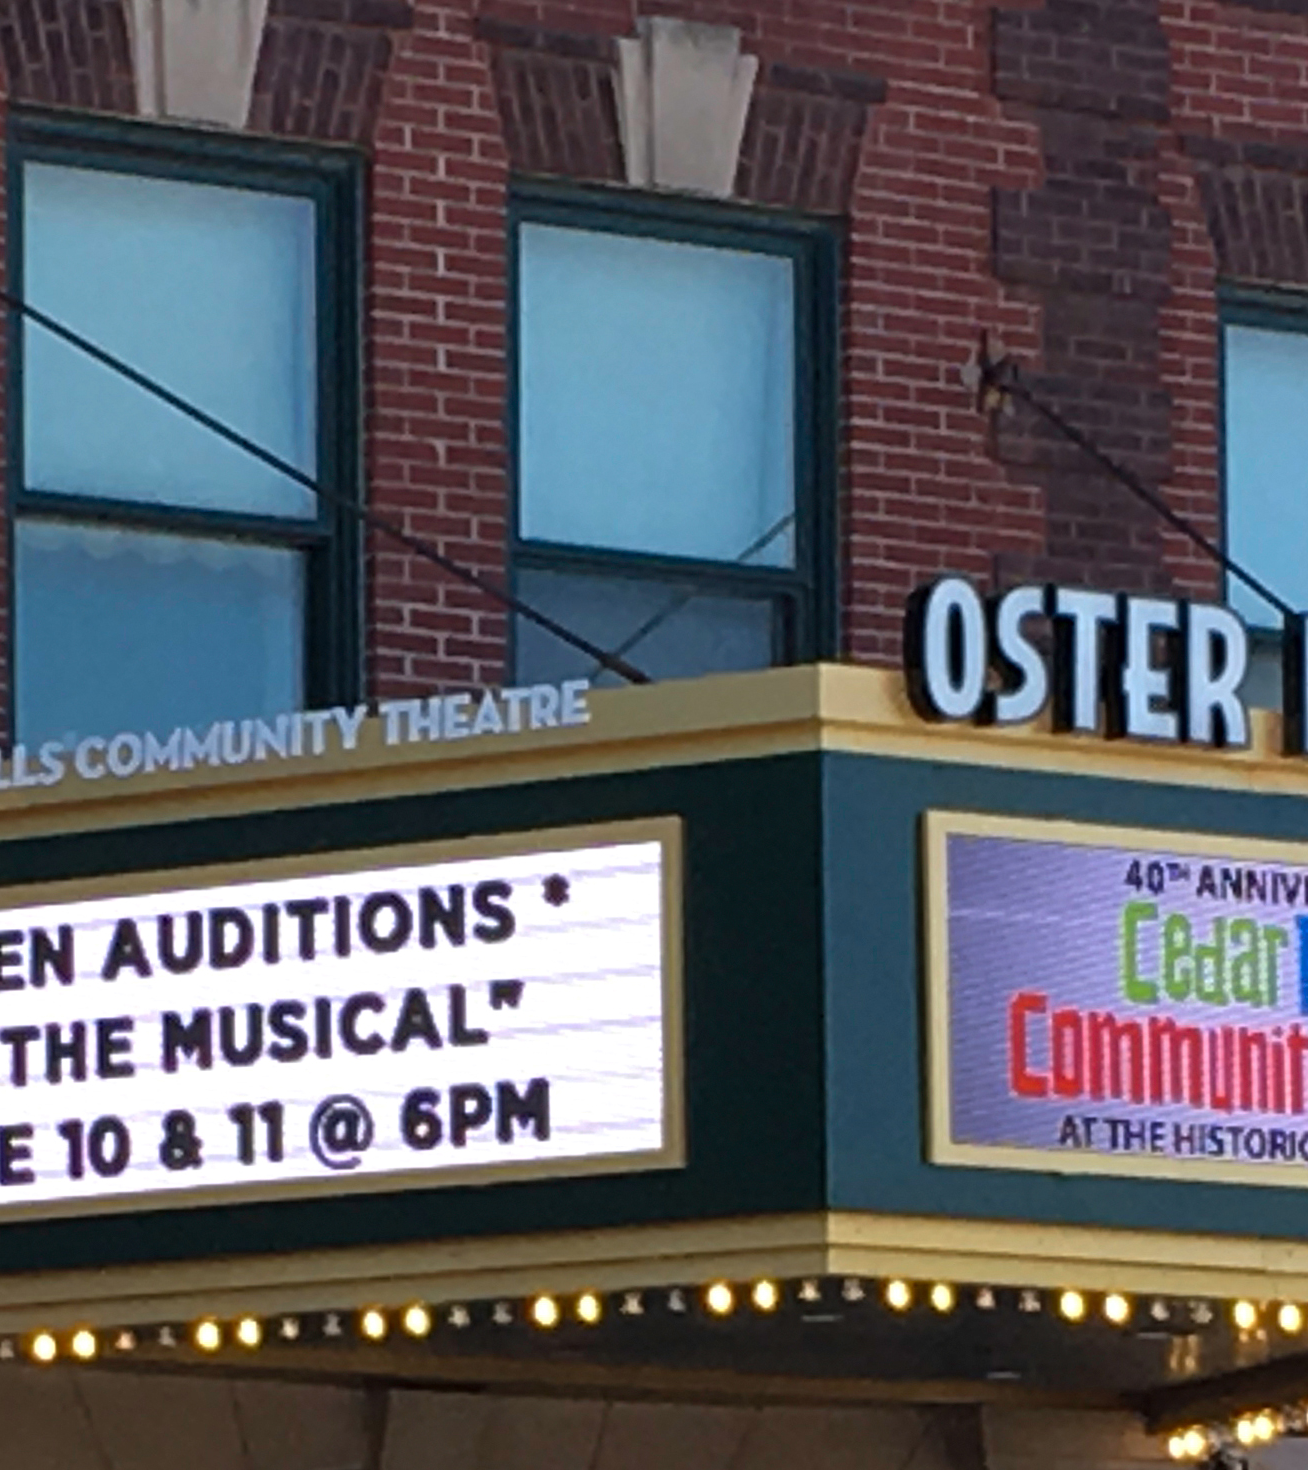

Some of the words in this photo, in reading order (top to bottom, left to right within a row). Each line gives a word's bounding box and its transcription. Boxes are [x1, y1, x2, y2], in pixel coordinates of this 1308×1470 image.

[907, 573, 1251, 750] OSTER
[74, 703, 368, 780] COMMUNITY
[378, 678, 592, 748] THEATRE
[103, 878, 517, 979] AUDITIONS
[1119, 898, 1290, 1009] Cedar
[60, 1115, 129, 1179] 10
[159, 1109, 203, 1170] &
[230, 1101, 285, 1164] 11
[308, 1094, 374, 1171] @
[402, 1077, 551, 1152] 6PM
[1059, 1114, 1097, 1149] AT
[1104, 1117, 1166, 1153] THE
